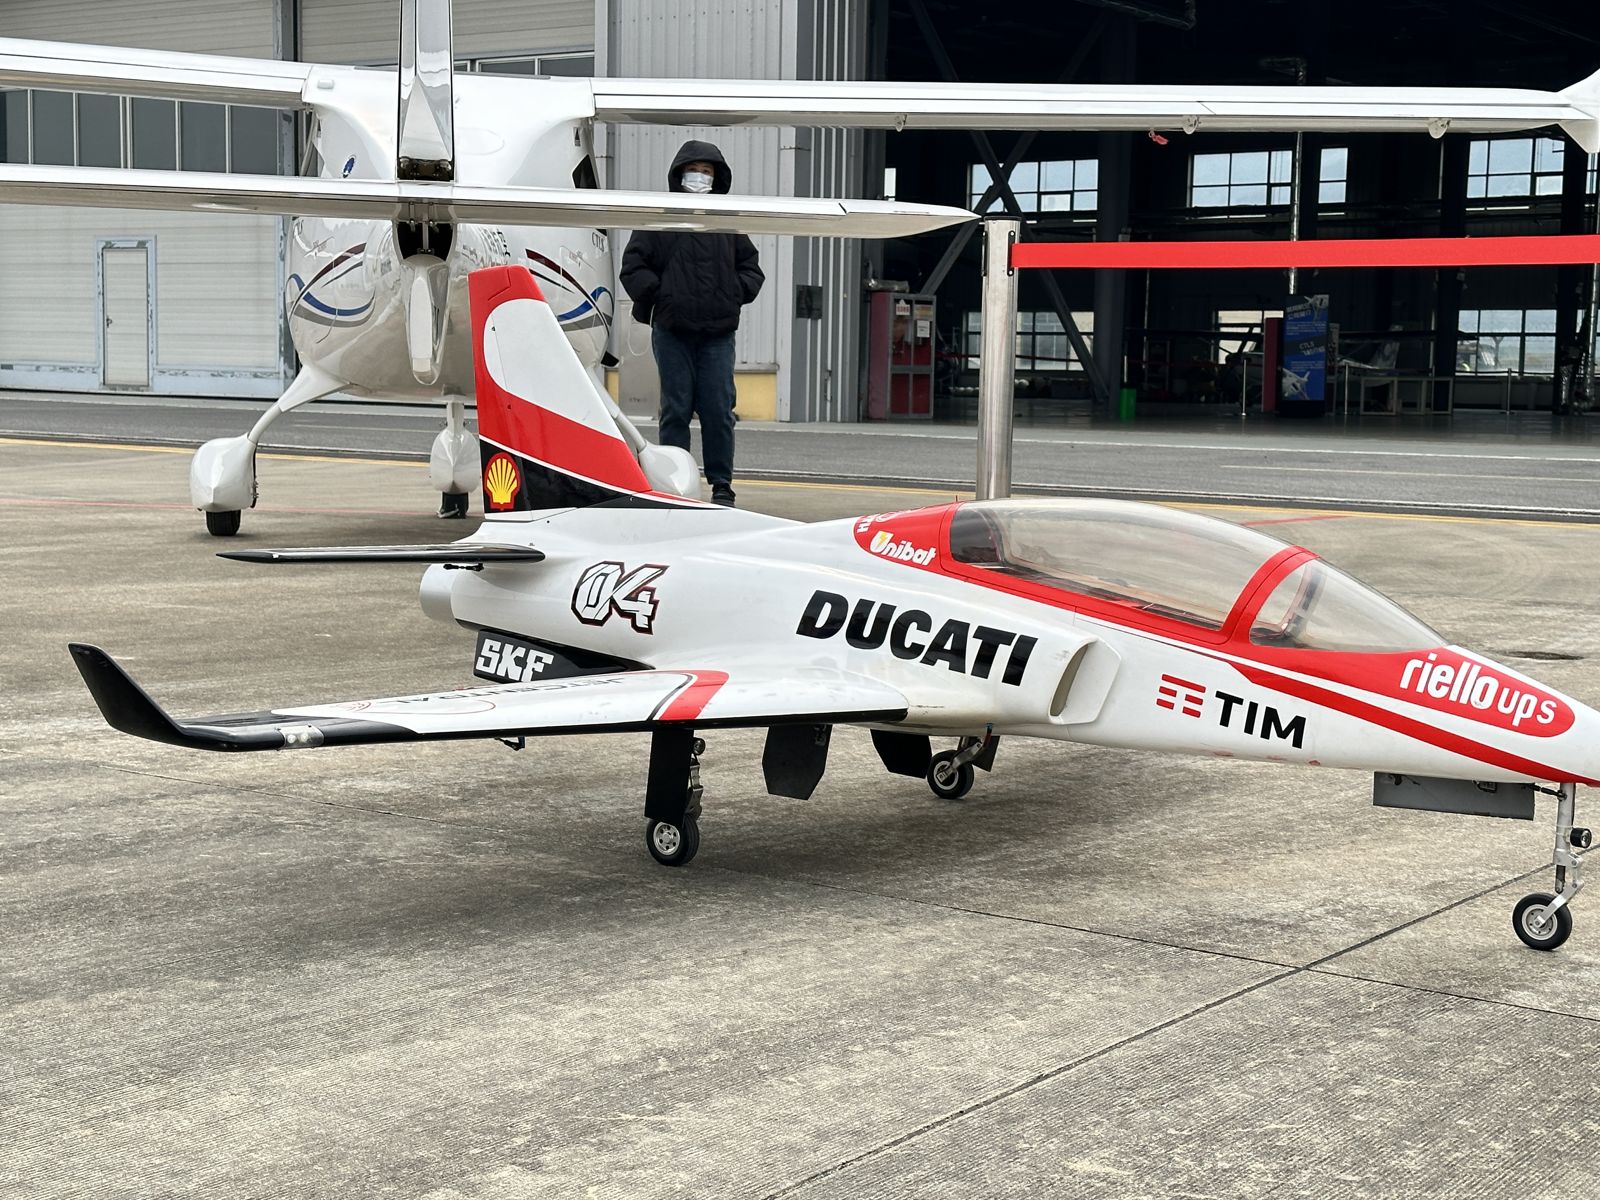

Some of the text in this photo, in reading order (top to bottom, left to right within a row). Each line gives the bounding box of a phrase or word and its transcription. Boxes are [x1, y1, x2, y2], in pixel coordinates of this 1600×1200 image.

[870, 530, 937, 566] Unibat
[571, 560, 670, 635] 04
[475, 638, 554, 682] SKF
[796, 589, 1039, 687] DUCATI
[1214, 690, 1307, 749] TIM
[1400, 653, 1558, 726] riello ups
